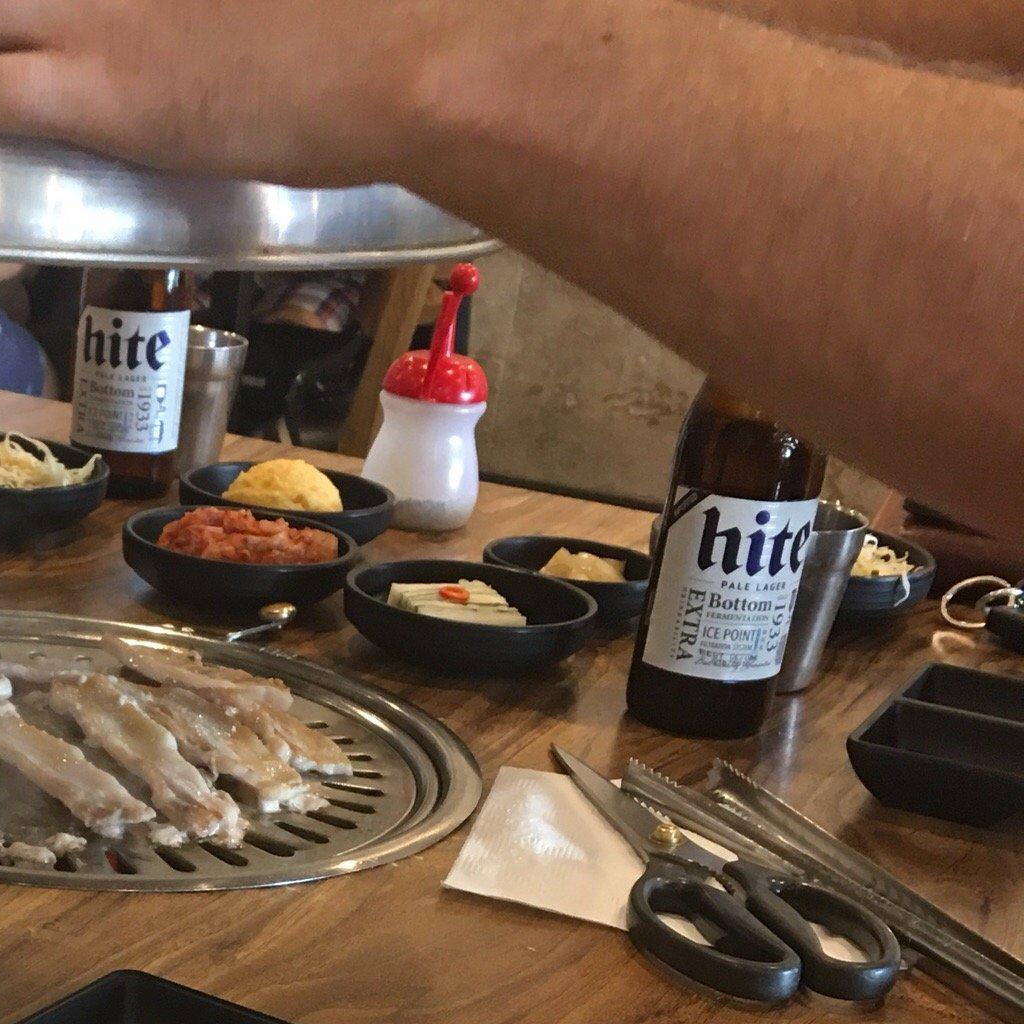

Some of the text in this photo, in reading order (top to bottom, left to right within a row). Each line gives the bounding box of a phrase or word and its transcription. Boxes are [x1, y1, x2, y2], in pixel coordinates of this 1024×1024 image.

[84, 314, 172, 372] hite
[135, 393, 151, 432] 1933
[697, 506, 811, 577] hite
[707, 592, 773, 612] Bottom
[720, 579, 786, 592] PALE LAGER
[676, 588, 706, 661] EXTRA
[702, 625, 756, 642] ICE POINT
[766, 604, 786, 652] 1933
